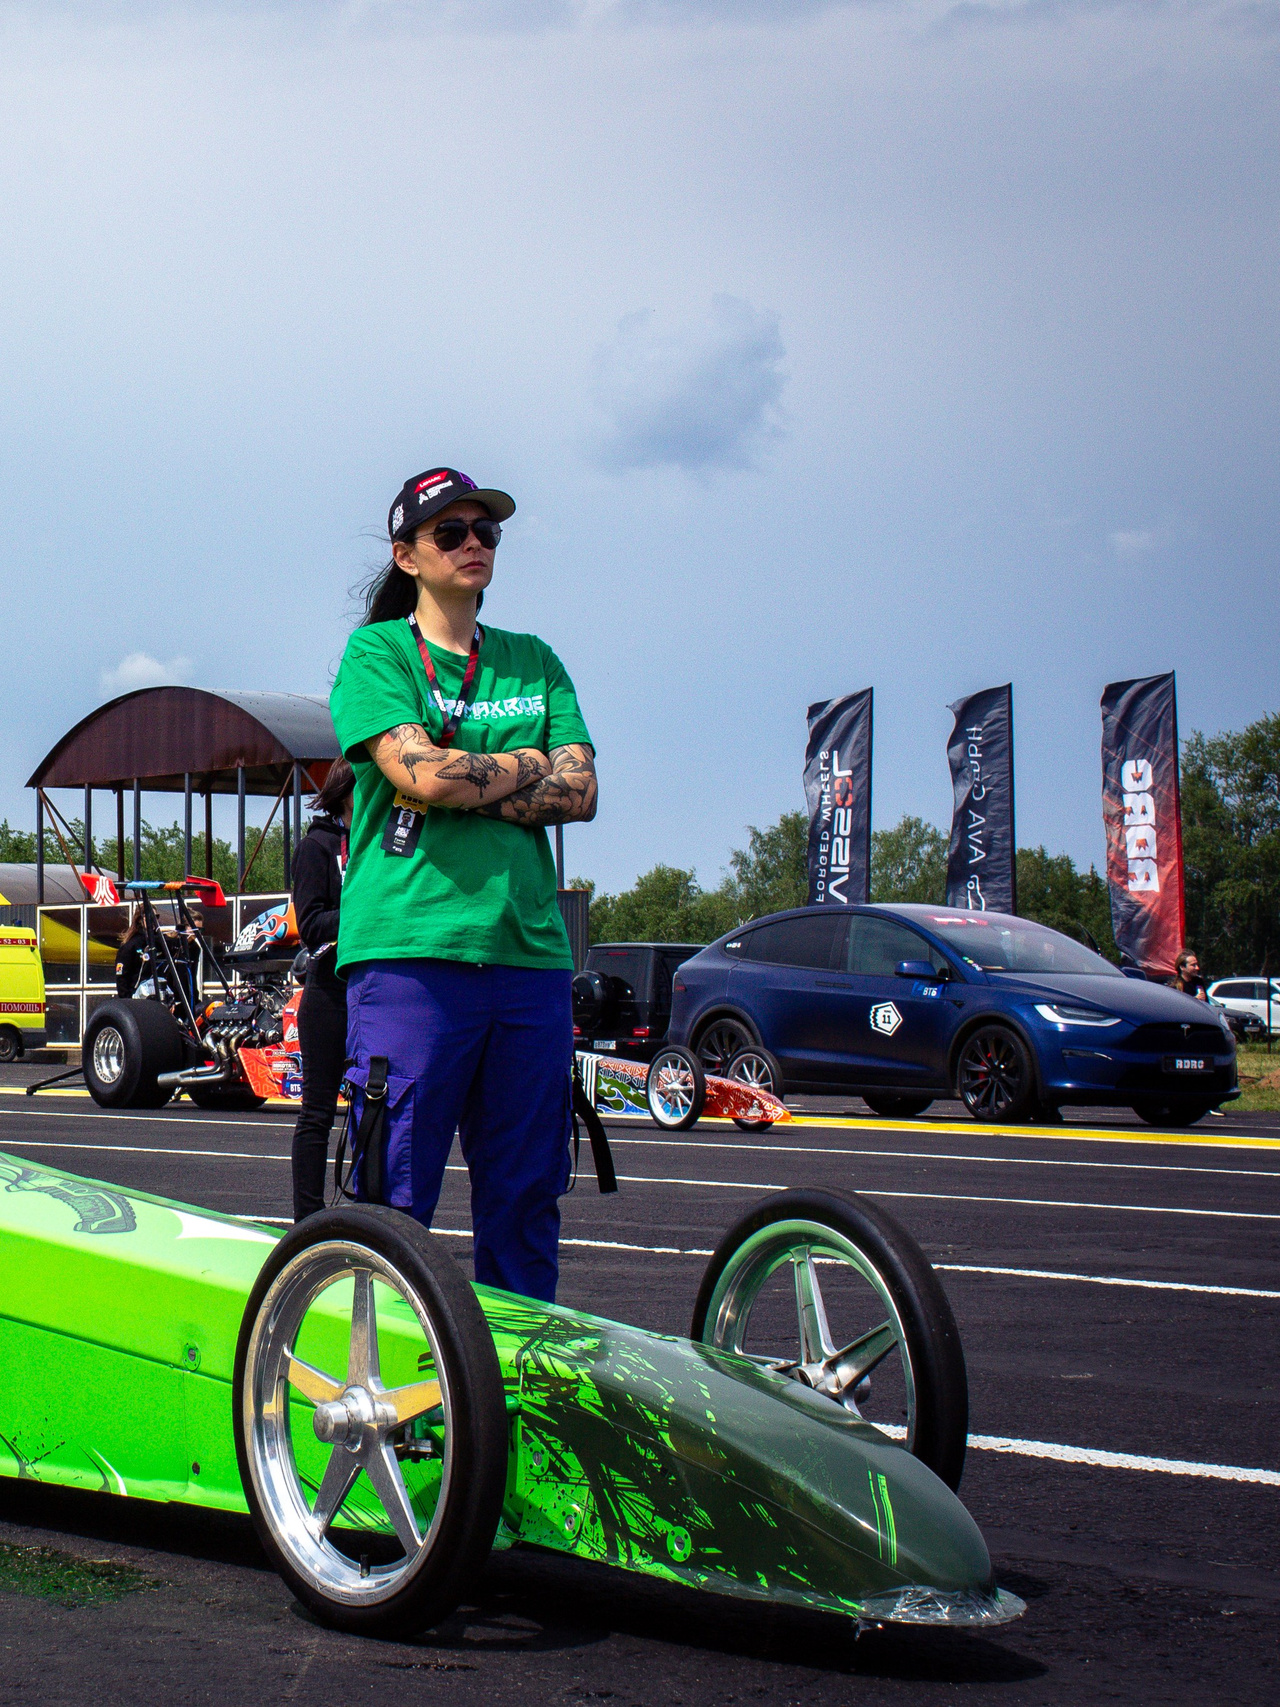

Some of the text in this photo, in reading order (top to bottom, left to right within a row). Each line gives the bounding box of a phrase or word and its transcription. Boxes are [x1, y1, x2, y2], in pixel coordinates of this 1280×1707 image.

[923, 987, 938, 997] ВТБ
[1, 1003, 40, 1012] ПОМОЩЬ
[882, 1014, 891, 1024] 11
[1176, 1059, 1204, 1069] RDRC
